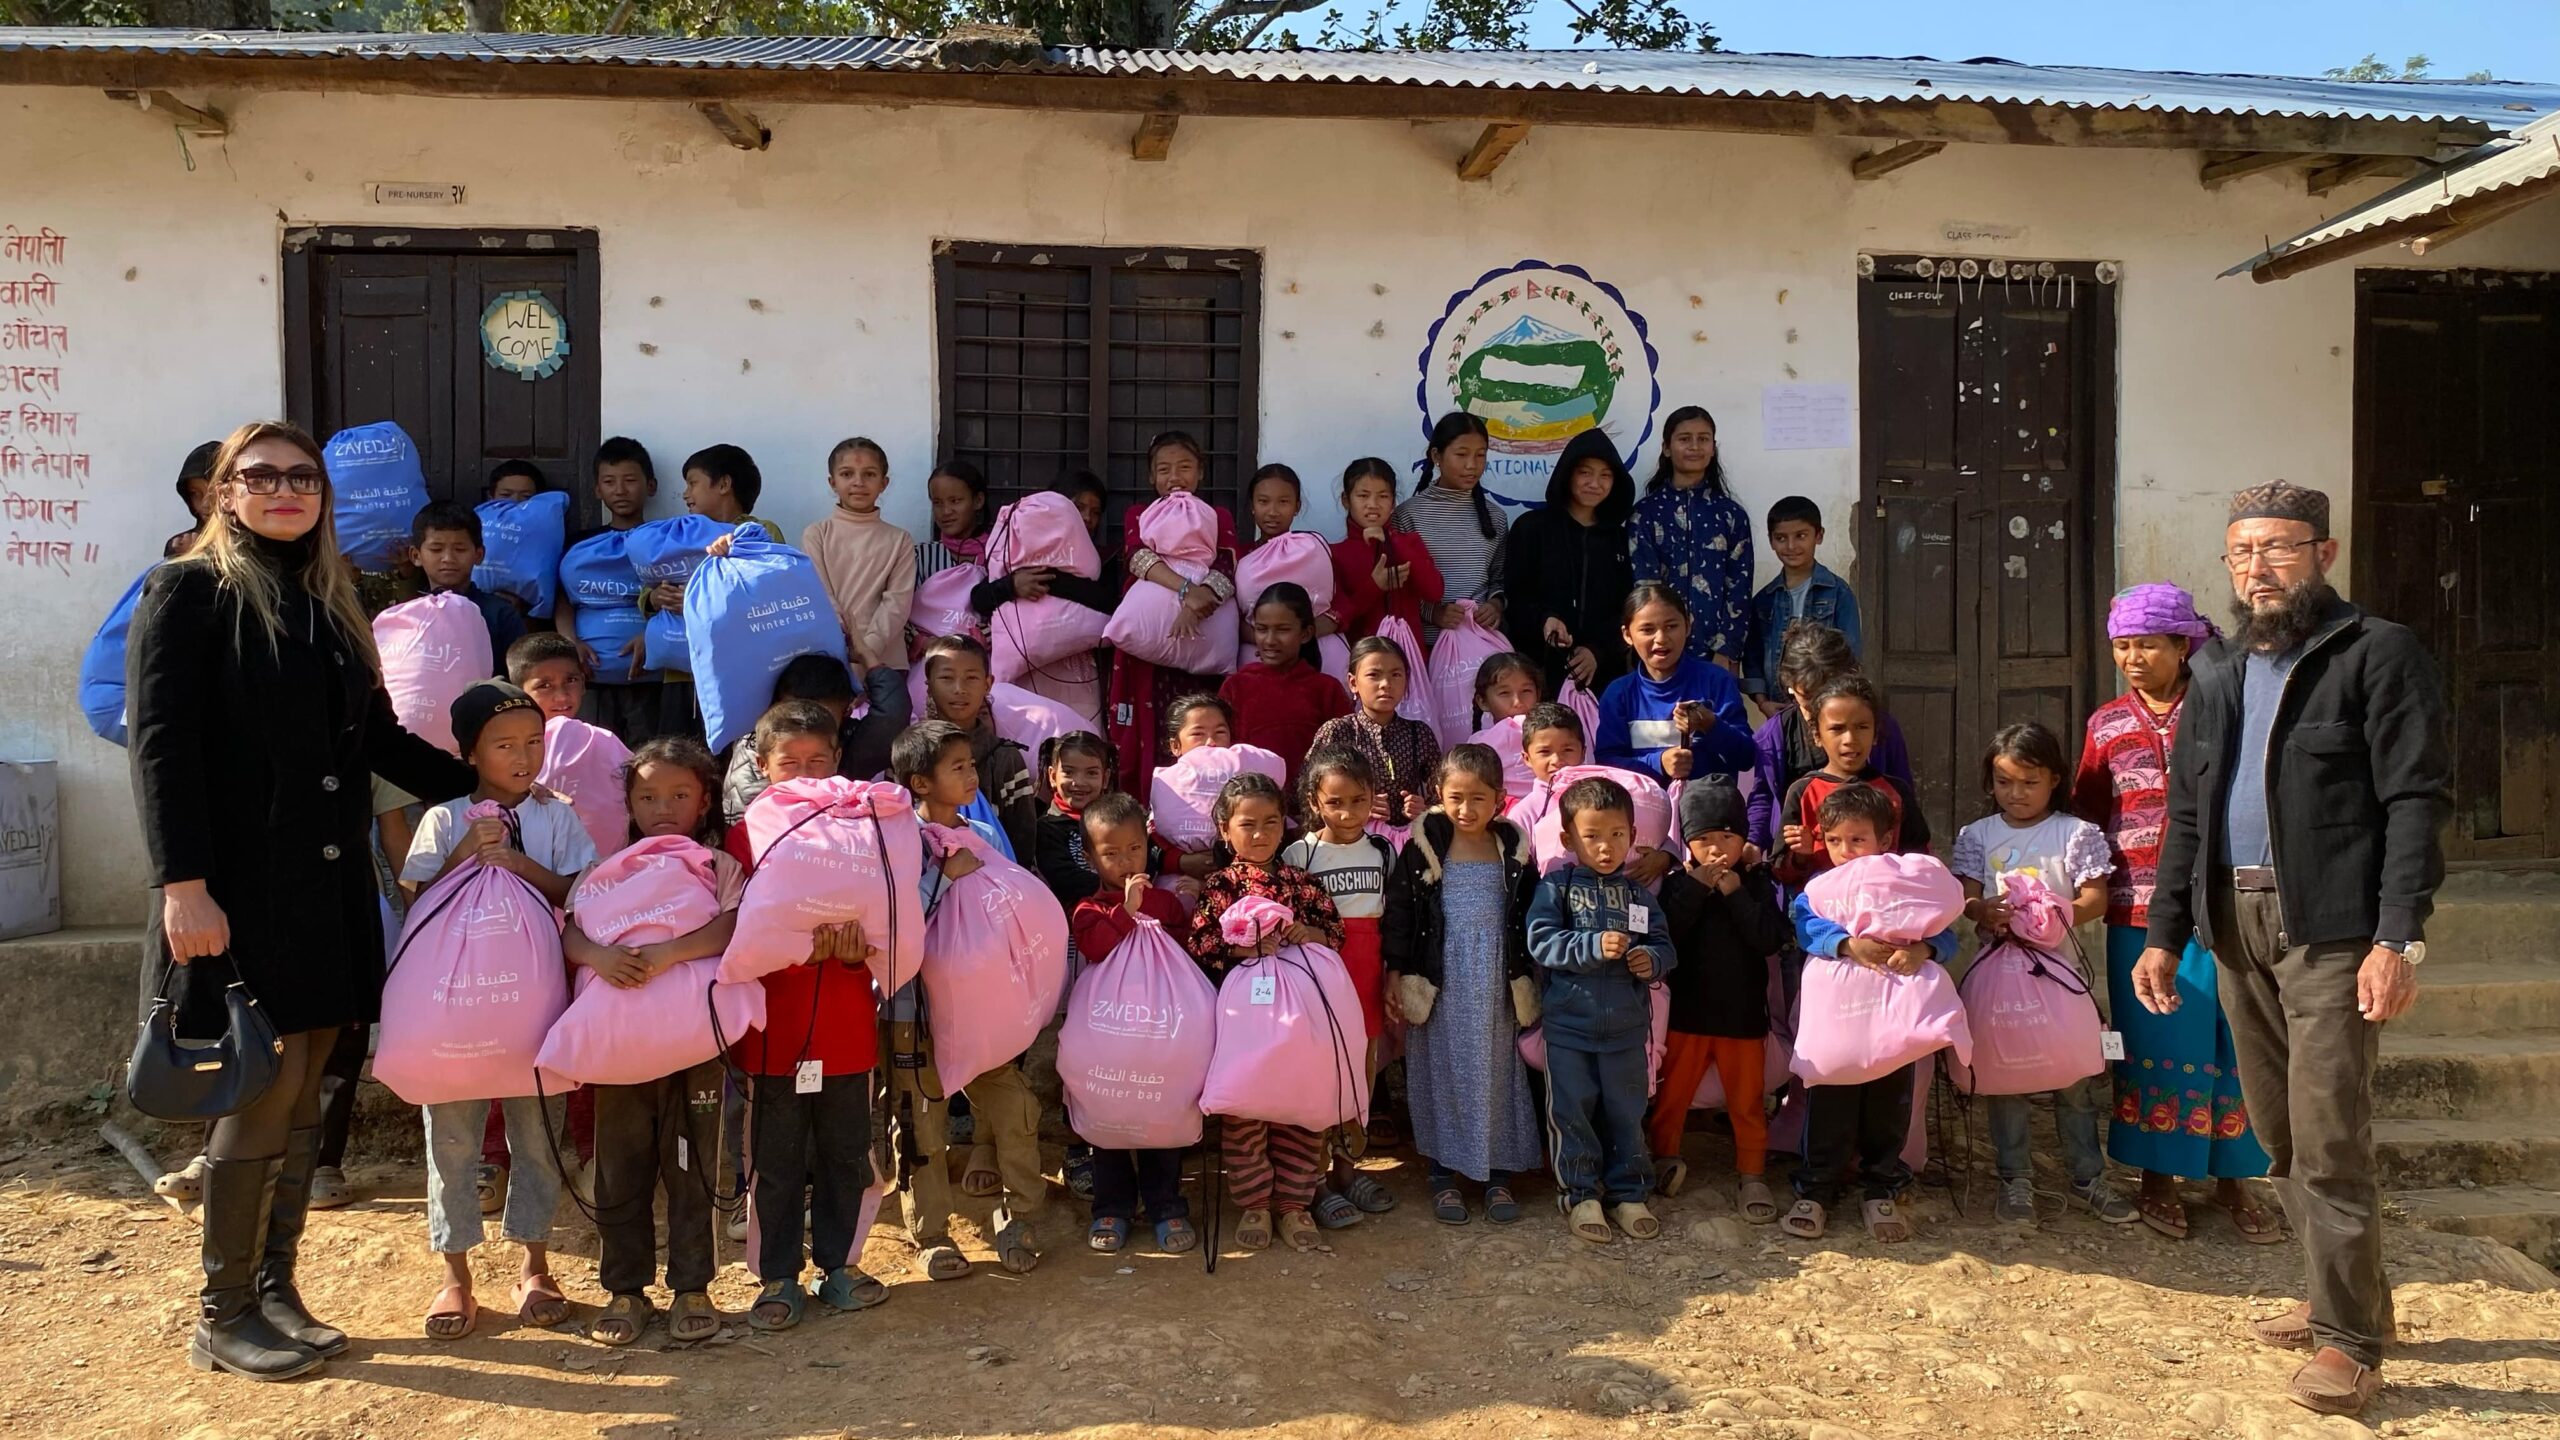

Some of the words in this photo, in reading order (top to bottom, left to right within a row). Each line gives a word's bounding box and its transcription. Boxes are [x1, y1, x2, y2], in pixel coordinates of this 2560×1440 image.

[4, 224, 69, 268] नेपाली
[505, 303, 551, 330] WEL
[497, 336, 553, 361] COME
[32, 446, 92, 489] नेपाल
[1485, 458, 1555, 480] ATIONAL-
[6, 531, 74, 577] नेपाल
[579, 578, 628, 596] ZAYED
[747, 602, 779, 620] الشتاء
[781, 595, 811, 611] حقيبة
[749, 616, 791, 633] Winter
[795, 608, 816, 622] bag
[794, 850, 845, 869] Winter
[852, 861, 877, 877] bag
[633, 904, 674, 922] حقيبة
[1632, 914, 1645, 924] 2-4
[476, 969, 519, 987] حقيبة
[491, 990, 519, 1004] bag
[1255, 987, 1271, 996] 2-4
[1091, 1000, 1149, 1023] ZAYED
[2105, 1041, 2119, 1050] 5-7
[800, 1073, 817, 1084] 5-7
[1087, 1064, 1126, 1082] الشتاء
[1129, 1070, 1165, 1087] حقيبة
[1086, 1081, 1130, 1098] Winter
[1138, 1085, 1162, 1102] bag
